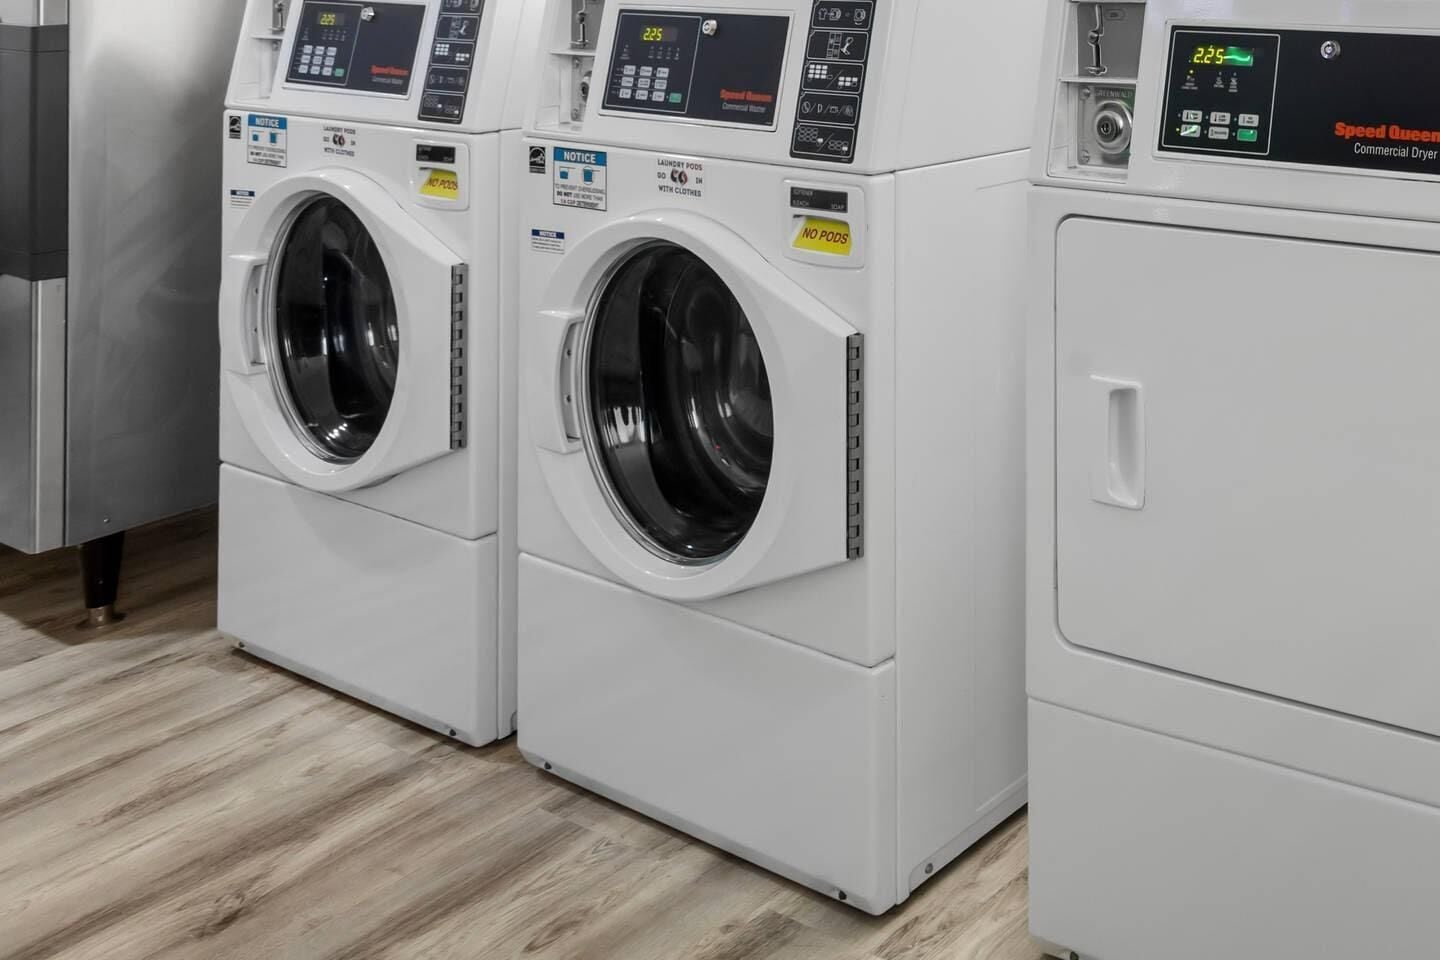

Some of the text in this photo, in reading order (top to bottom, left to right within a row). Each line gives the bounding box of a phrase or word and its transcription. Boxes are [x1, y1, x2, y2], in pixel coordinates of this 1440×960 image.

[1335, 122, 1386, 139] Speed
[563, 150, 597, 164] NOTICE
[1354, 142, 1438, 161] Commercial Dryer
[657, 159, 703, 171] LAUNDRY PODS
[658, 185, 674, 193] WITH
[802, 227, 849, 245] NO PODS
